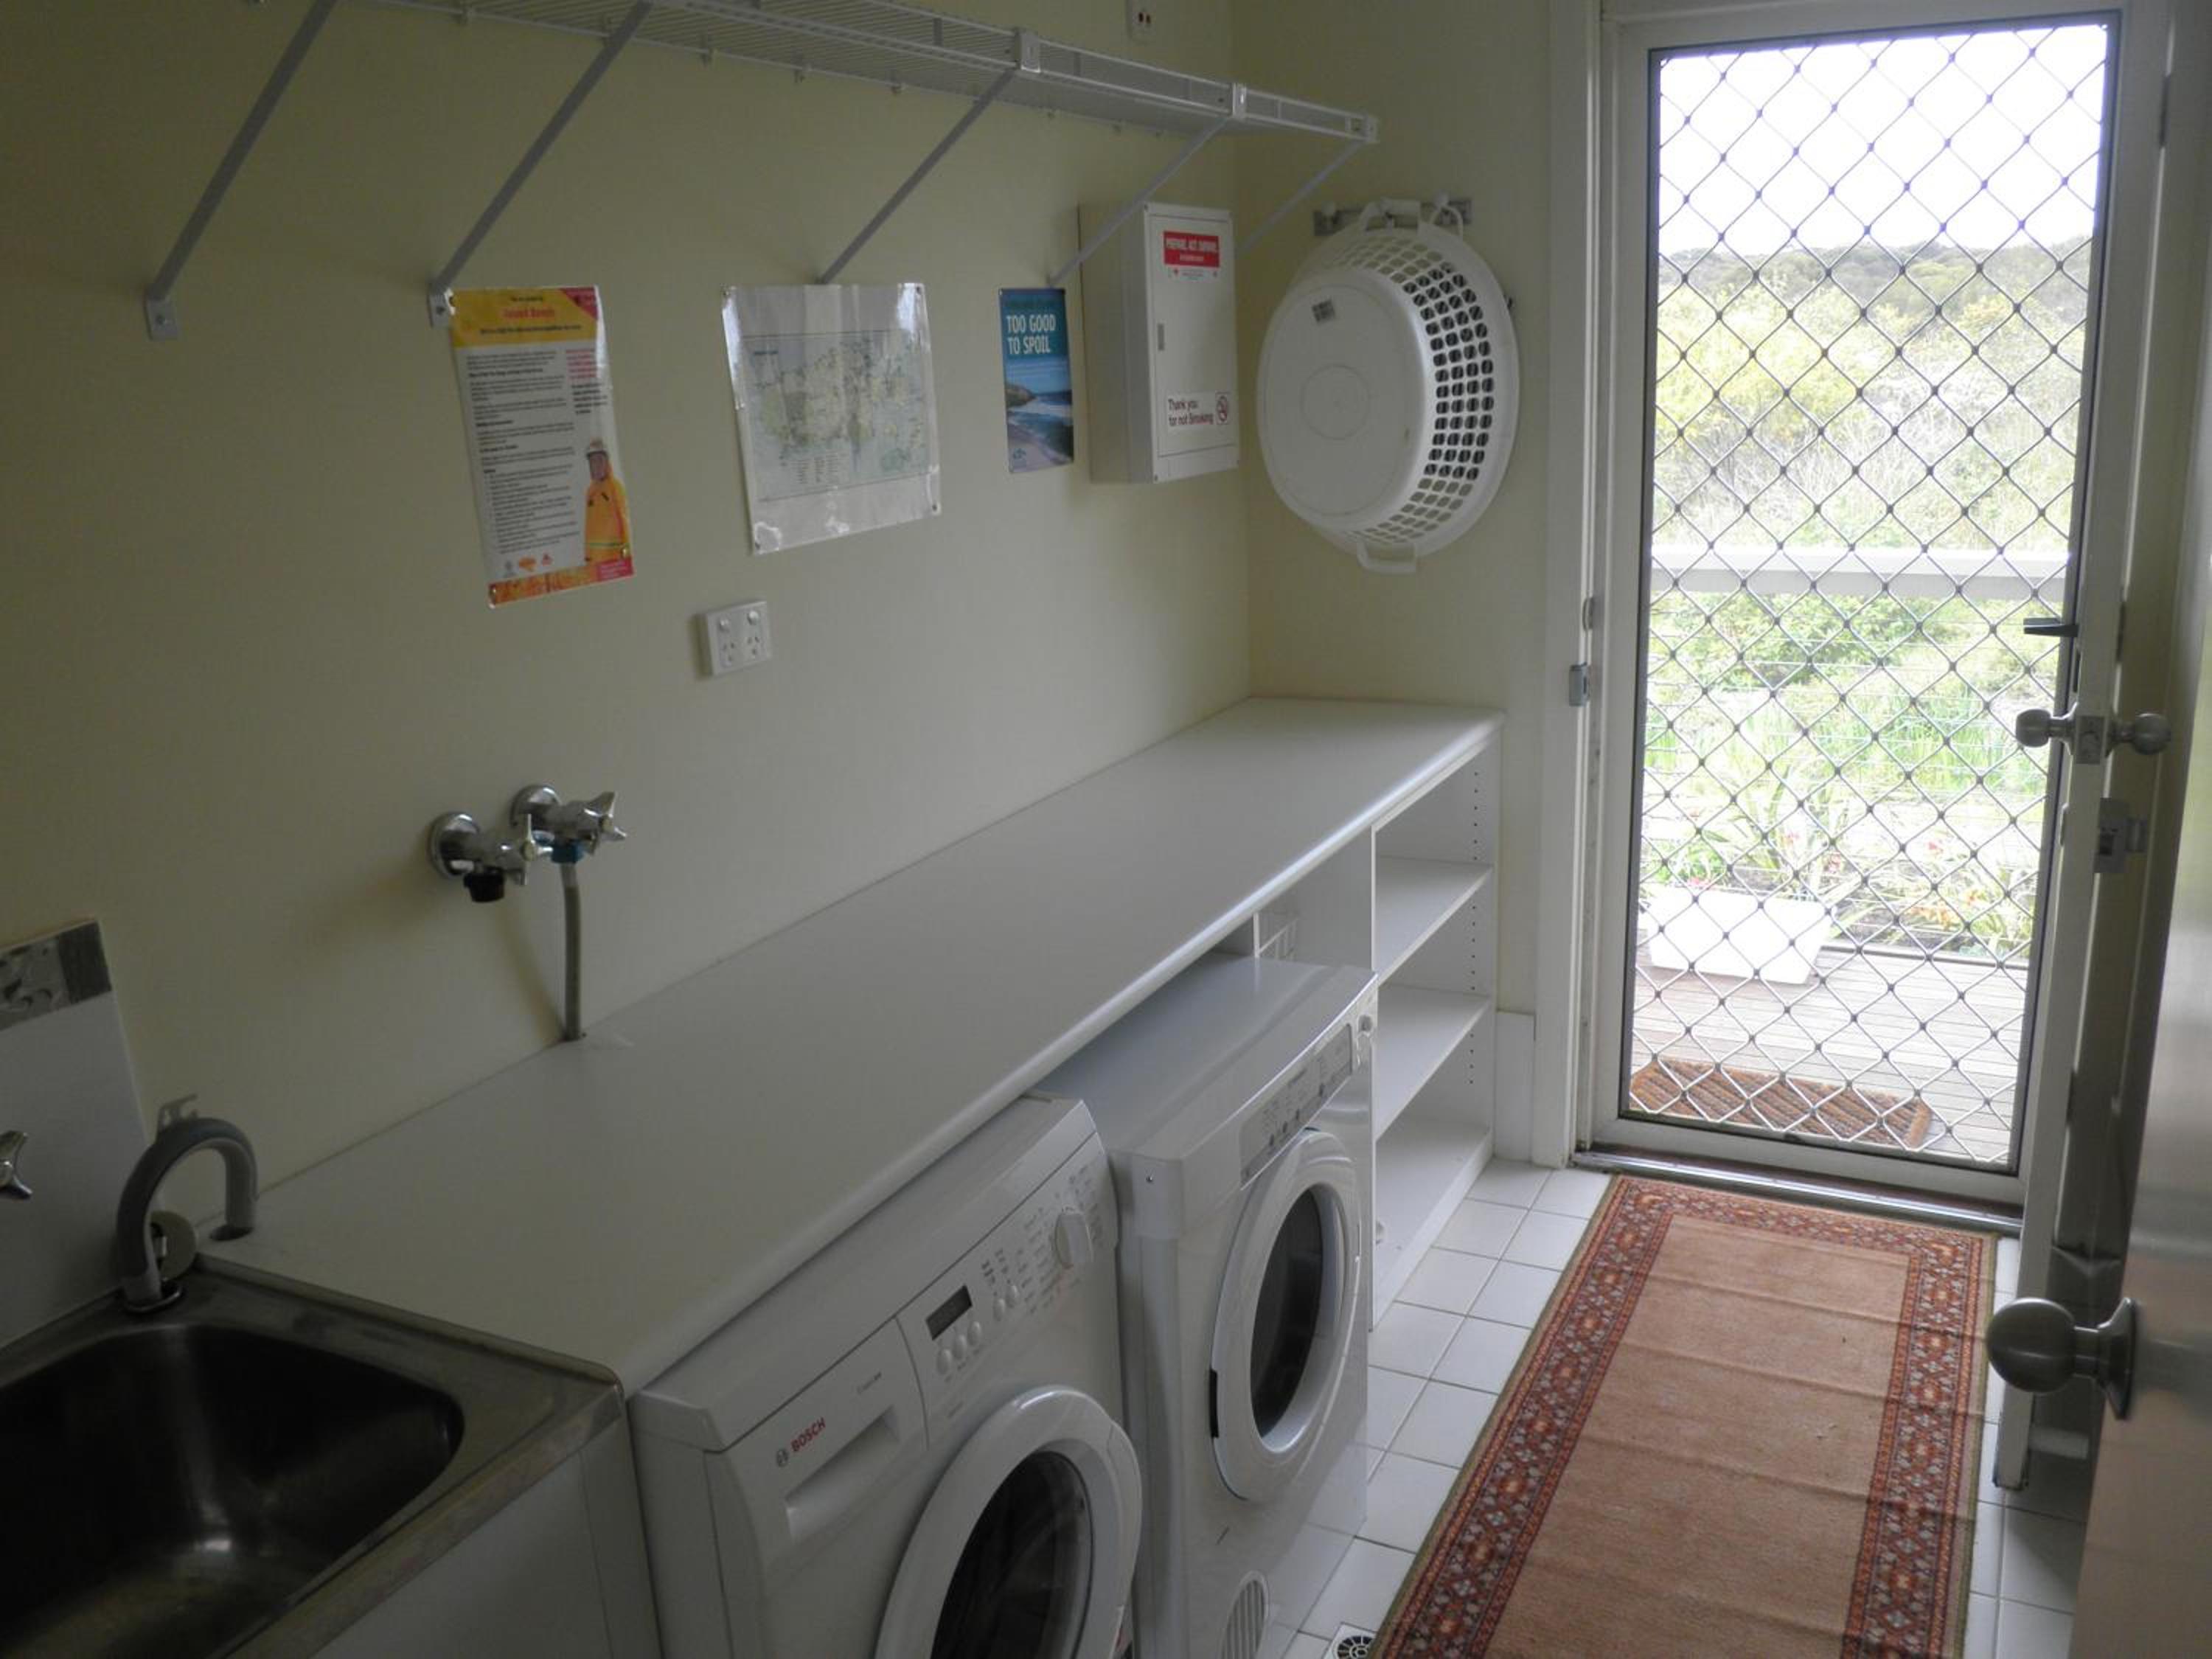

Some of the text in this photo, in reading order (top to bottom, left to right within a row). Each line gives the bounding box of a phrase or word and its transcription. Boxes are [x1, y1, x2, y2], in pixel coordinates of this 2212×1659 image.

[1006, 313, 1057, 333] TOO GOOD
[1007, 335, 1051, 355] TO SPOIL
[1168, 398, 1186, 411] Thank
[790, 1416, 827, 1452] BOSCH
